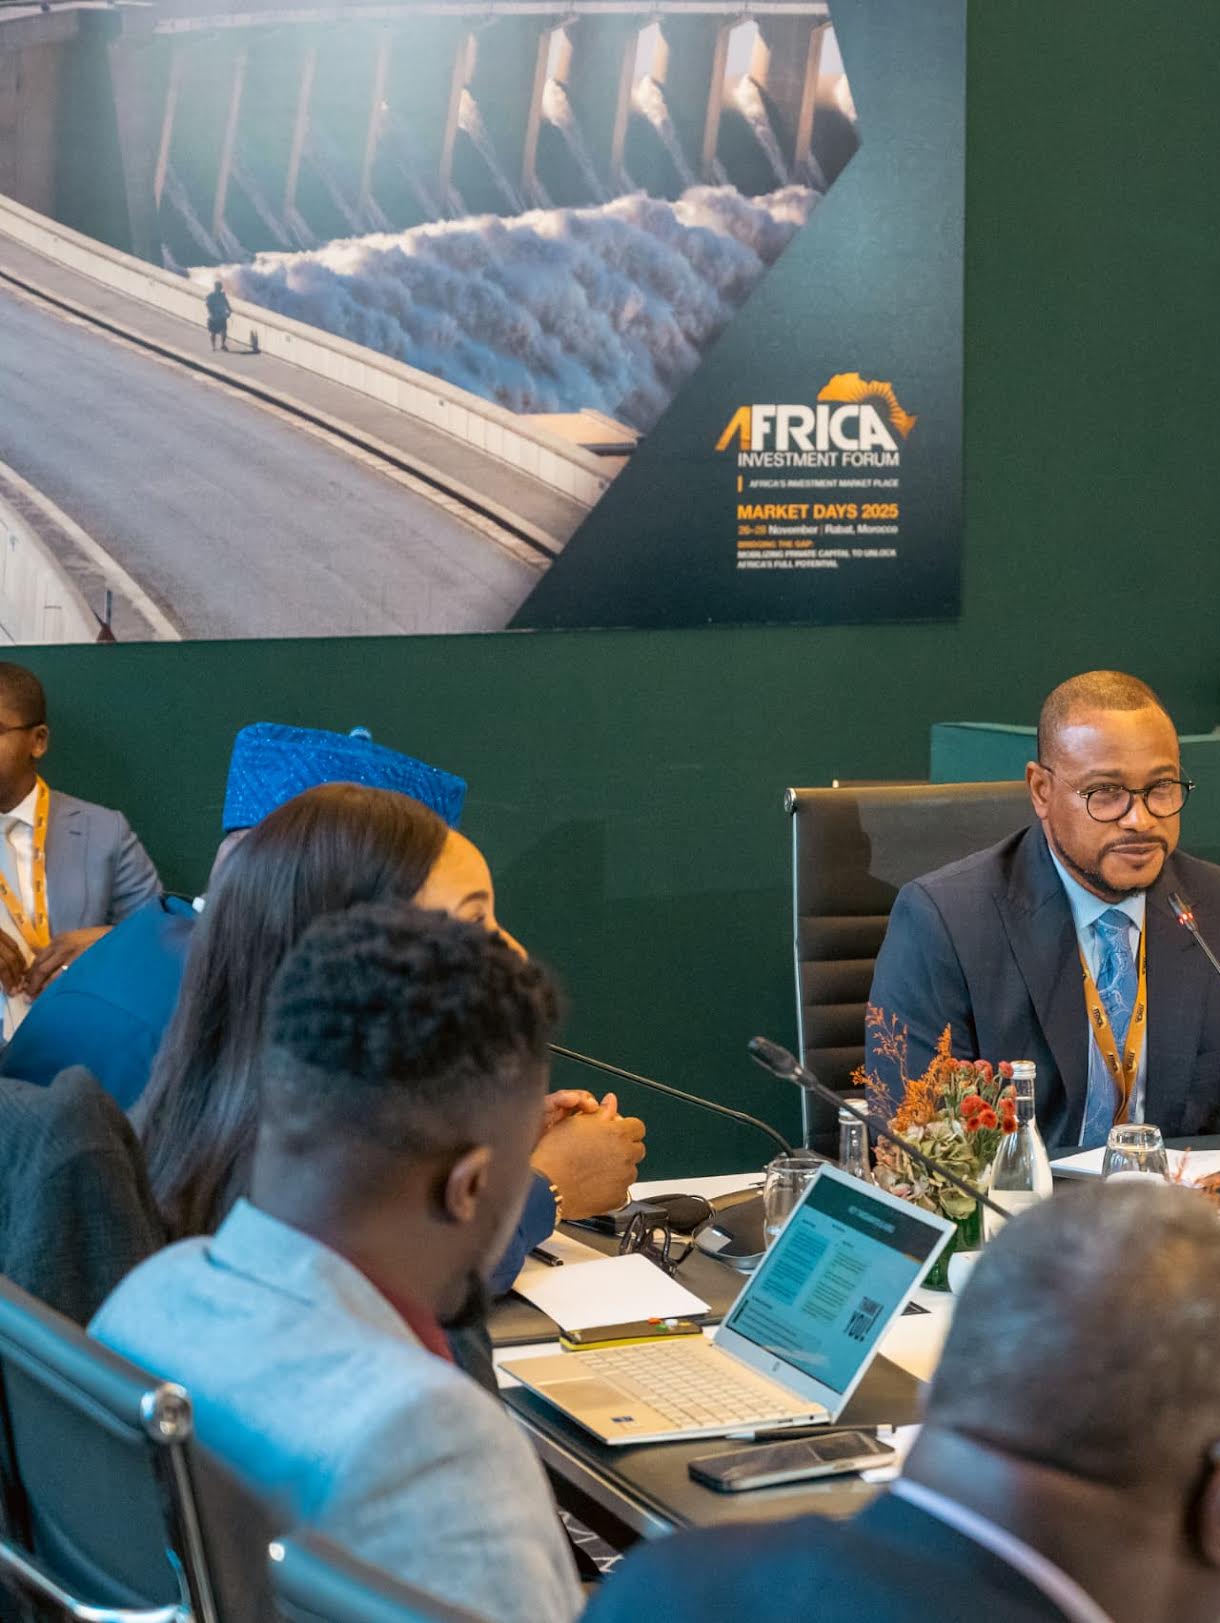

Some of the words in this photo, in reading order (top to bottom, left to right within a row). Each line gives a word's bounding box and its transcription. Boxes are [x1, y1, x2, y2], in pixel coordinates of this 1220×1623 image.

[715, 404, 899, 451] AFRICA
[738, 452, 838, 467] INVESTMENT
[842, 452, 900, 466] FORUM
[737, 504, 809, 520] MARKET
[813, 504, 858, 519] DAYS
[861, 503, 899, 518] 2025
[768, 524, 818, 535] November
[857, 524, 899, 535] Morocco
